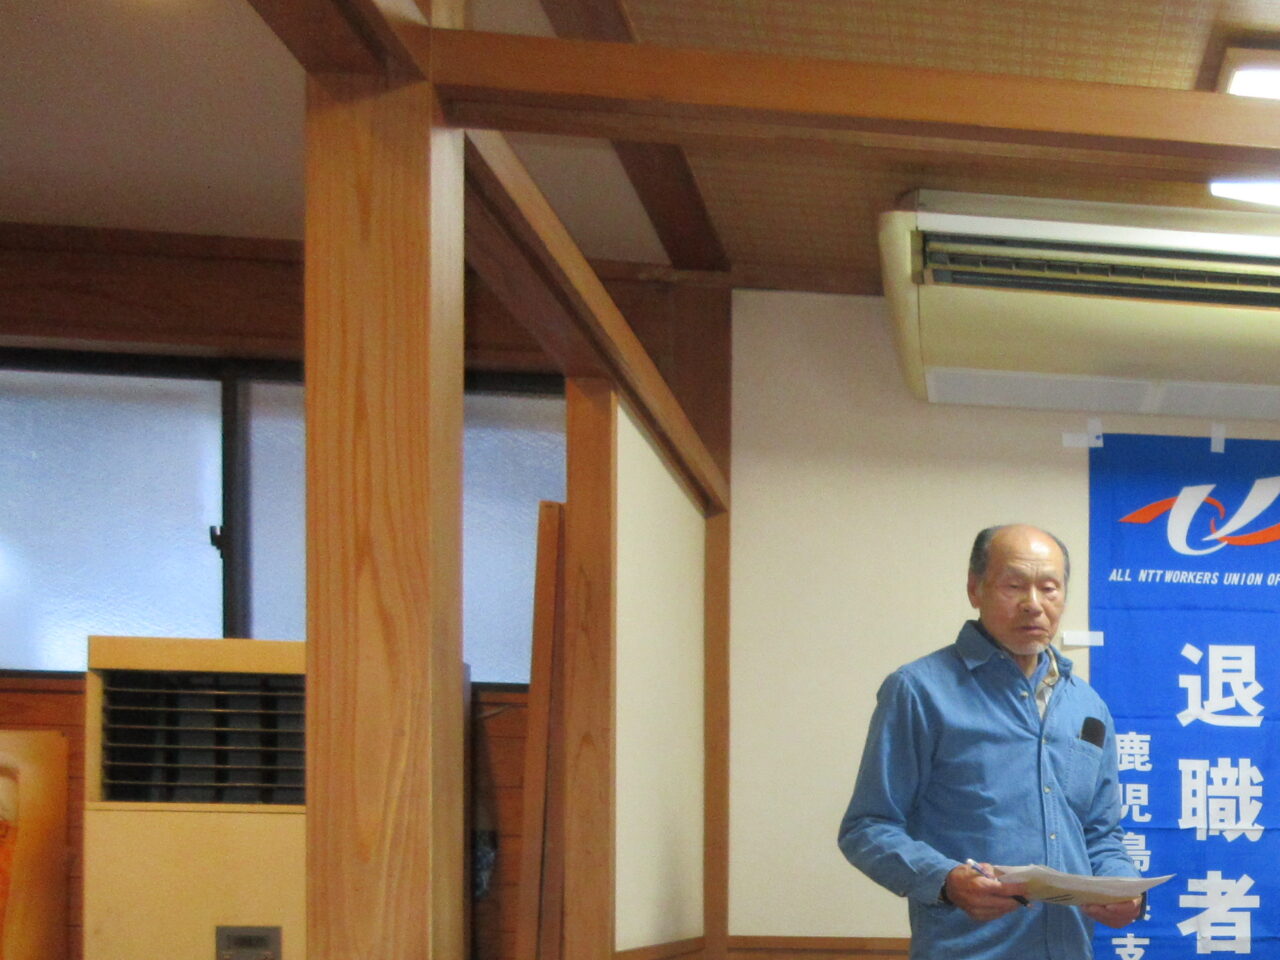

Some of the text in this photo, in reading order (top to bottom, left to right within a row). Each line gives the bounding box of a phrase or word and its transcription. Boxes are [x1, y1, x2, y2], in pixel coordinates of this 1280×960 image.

[1109, 568, 1132, 582] ALL
[1138, 569, 1163, 583] NTT
[1164, 570, 1220, 584] WORKERS
[1223, 572, 1263, 586] UNION
